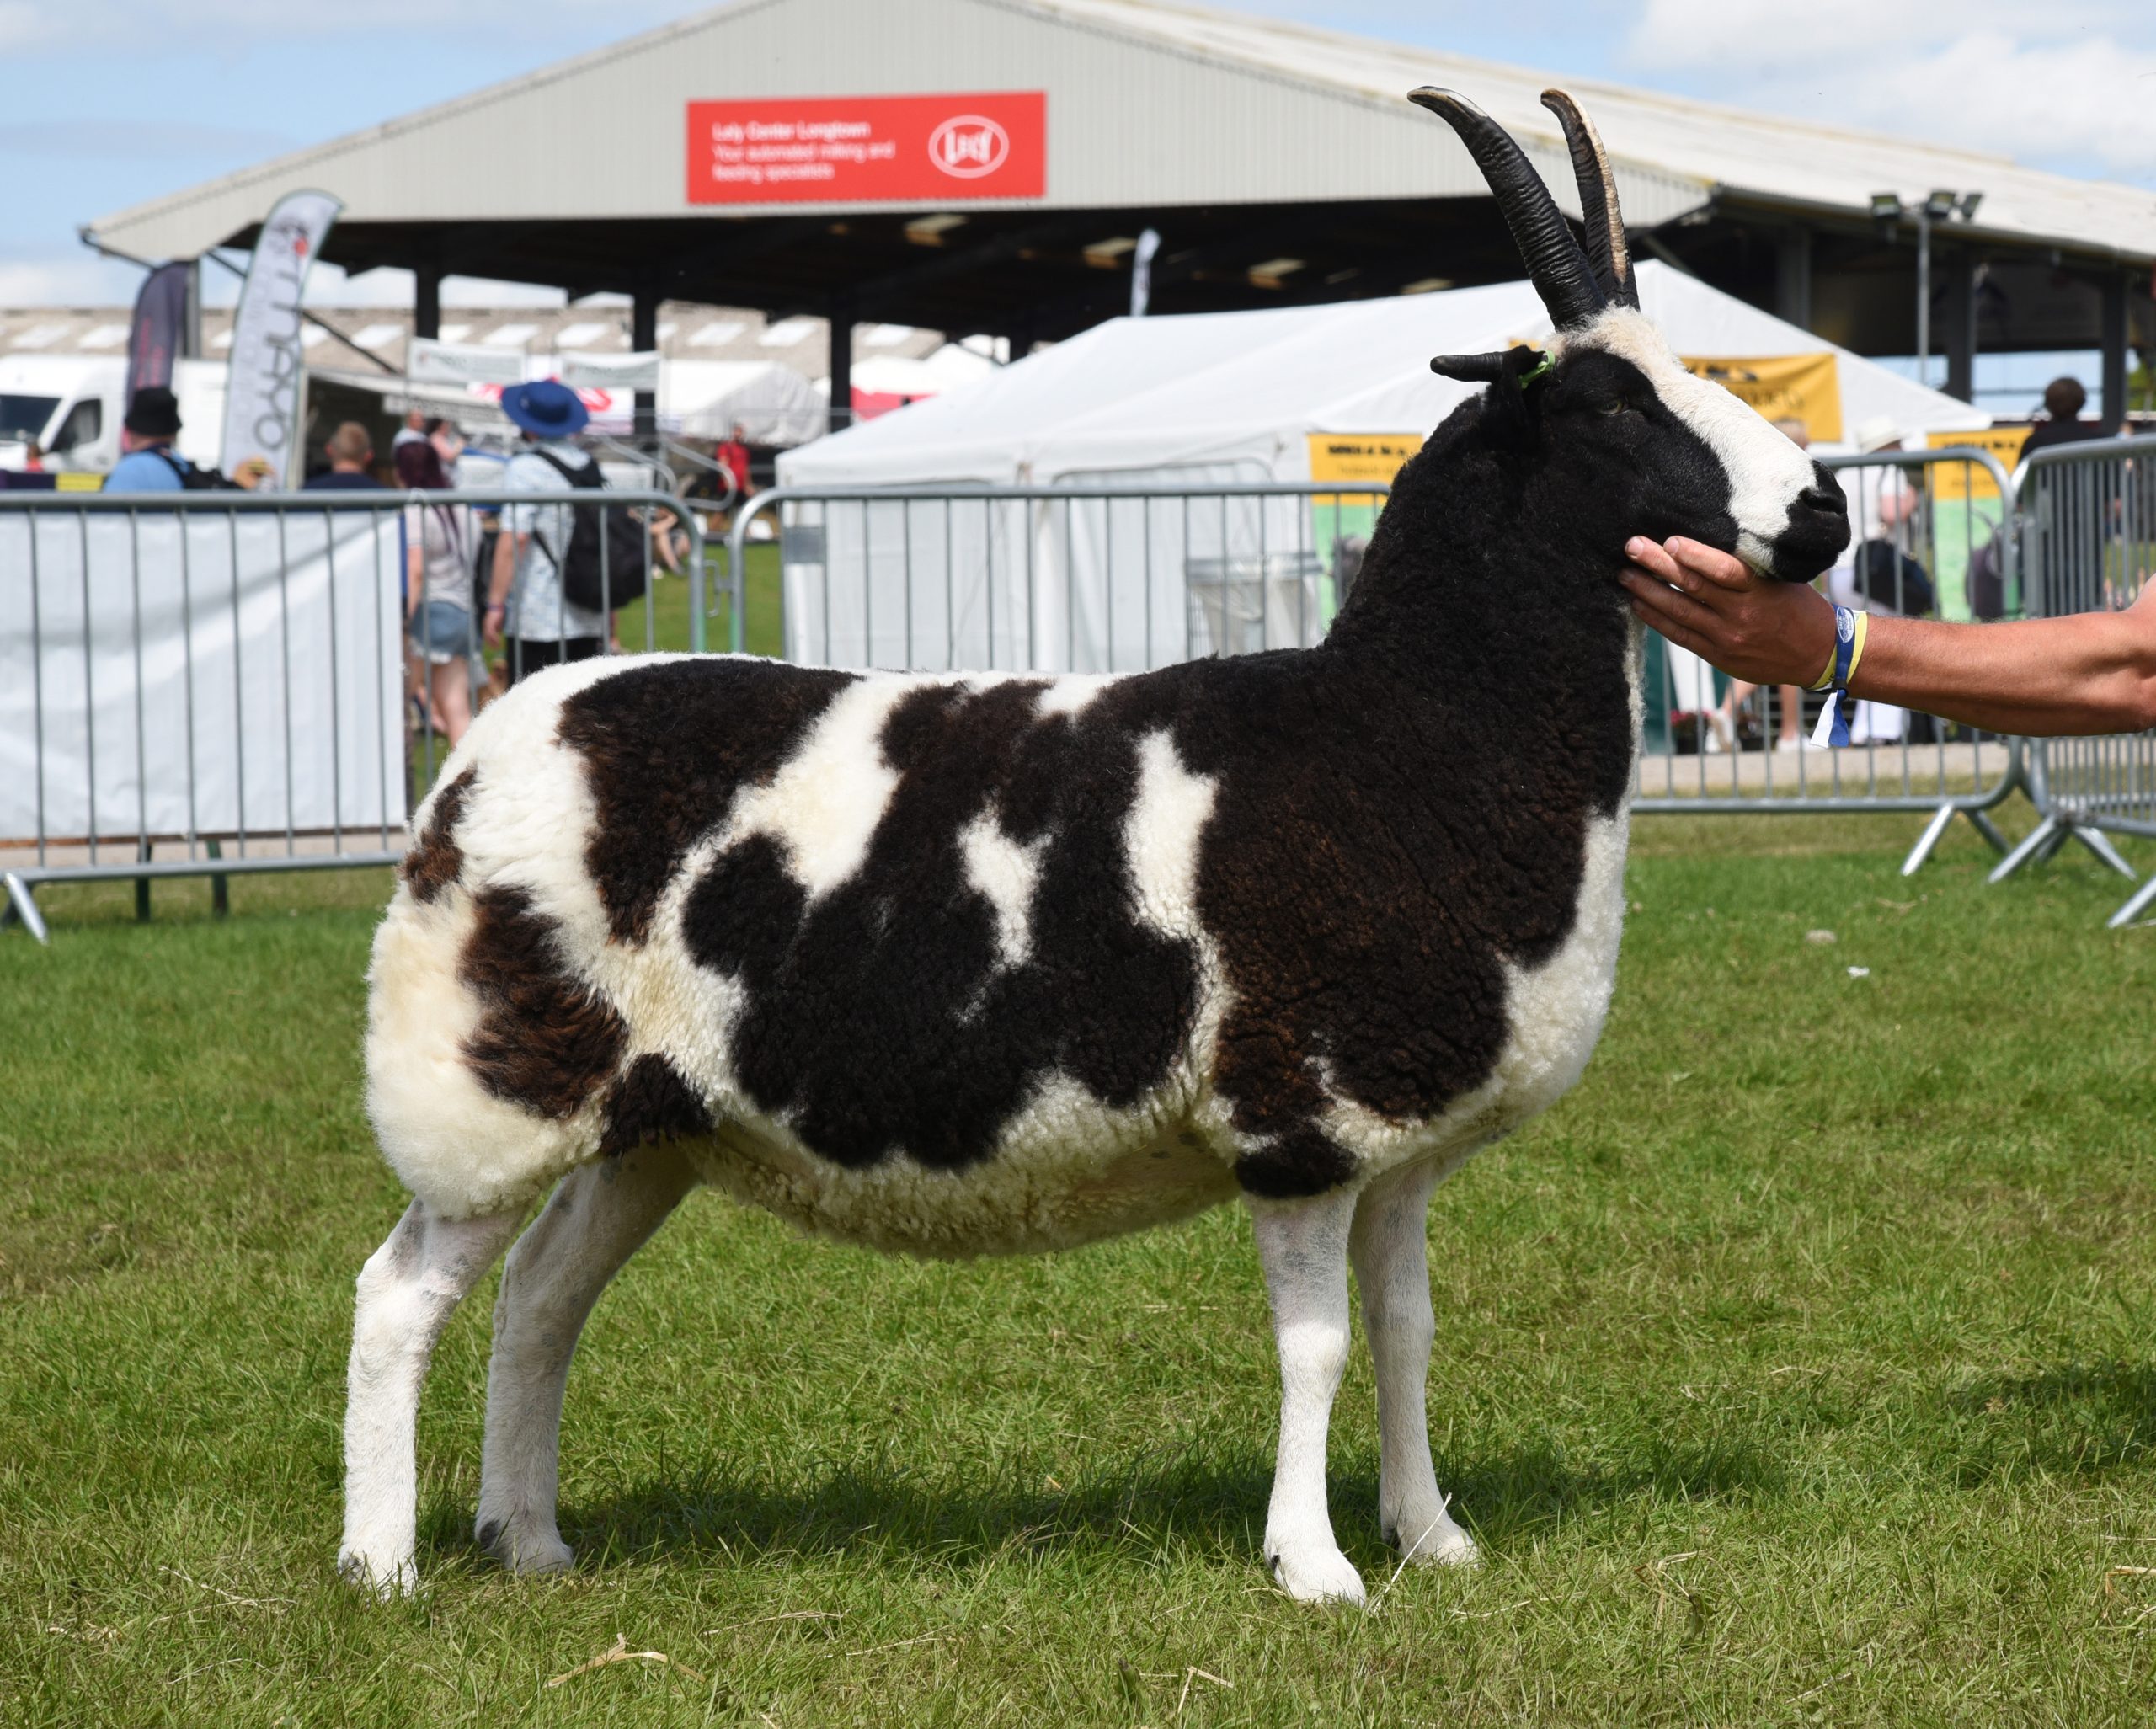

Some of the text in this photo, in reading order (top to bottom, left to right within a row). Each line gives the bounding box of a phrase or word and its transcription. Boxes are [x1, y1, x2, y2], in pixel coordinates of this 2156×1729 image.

[712, 120, 871, 144] Lely Center Longtown
[712, 140, 896, 163] Your automated milking and
[712, 163, 835, 184] feeding specialists
